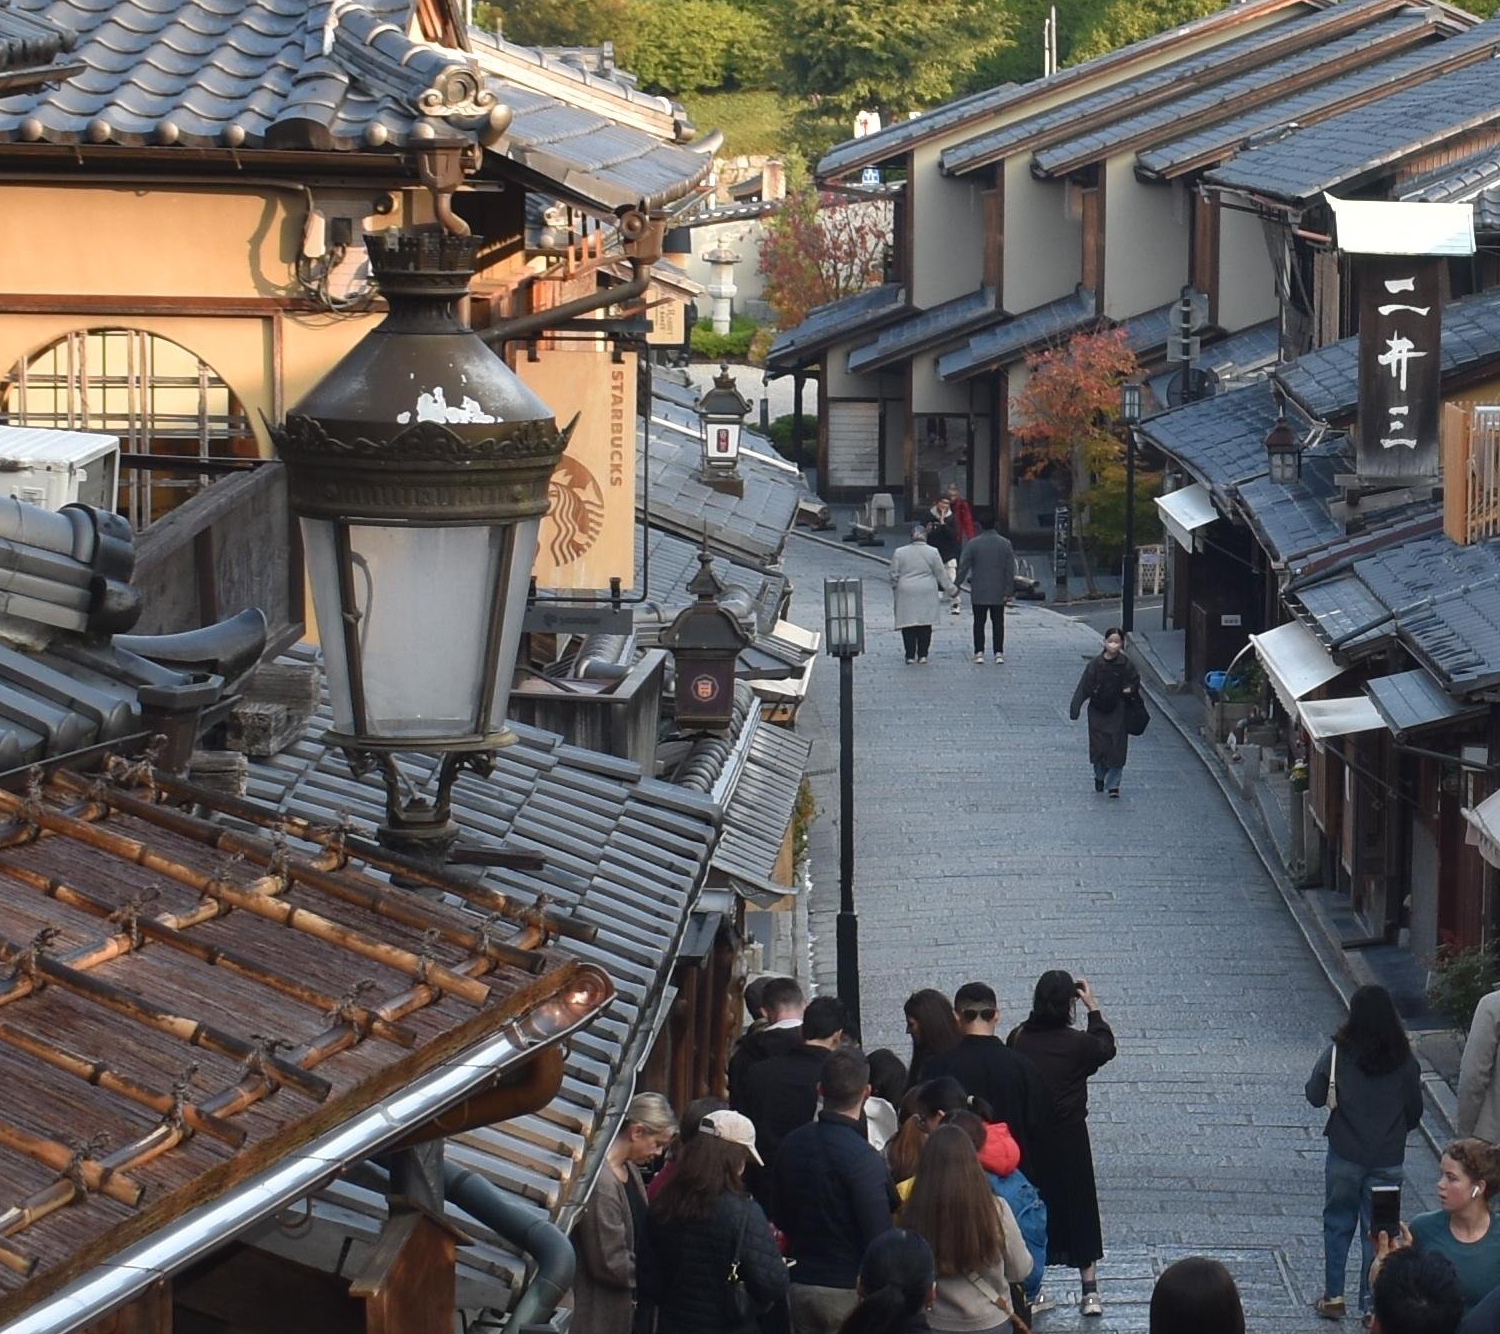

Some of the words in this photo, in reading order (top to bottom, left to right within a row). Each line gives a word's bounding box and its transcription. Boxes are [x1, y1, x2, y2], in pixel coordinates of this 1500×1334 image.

[609, 370, 625, 488] STARBUCKS
[1377, 276, 1431, 449] 二井三
